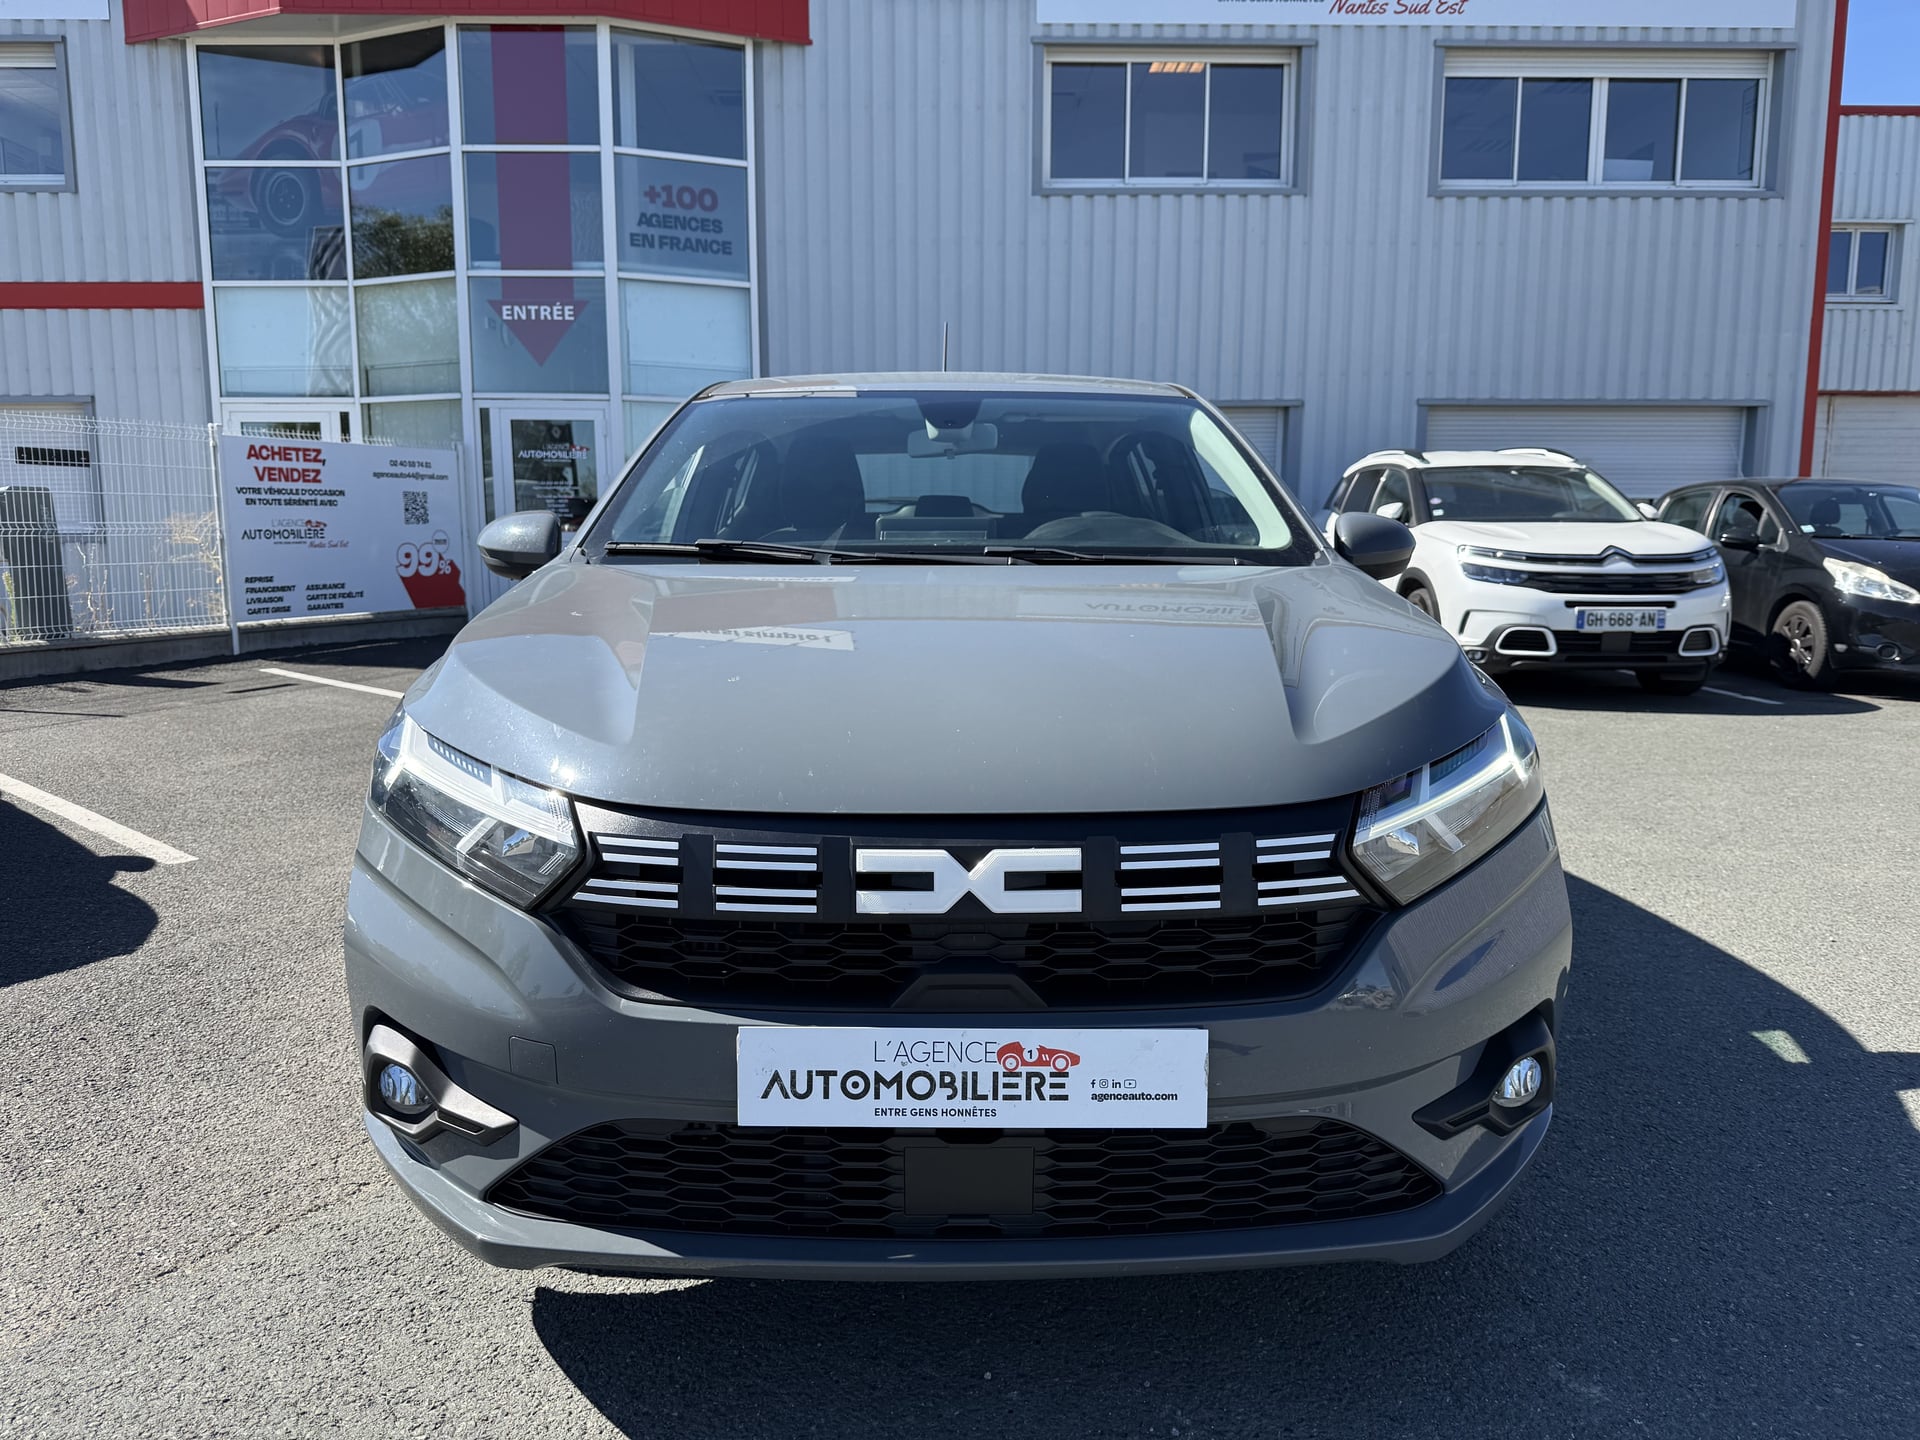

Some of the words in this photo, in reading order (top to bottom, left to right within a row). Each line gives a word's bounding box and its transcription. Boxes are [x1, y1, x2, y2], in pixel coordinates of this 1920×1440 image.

[1328, 0, 1387, 15] Nantes
[1393, 0, 1432, 15] Sud
[1435, 0, 1468, 15] Est
[644, 184, 718, 212] +100
[637, 212, 723, 234] AGENCES
[629, 232, 655, 249] EN
[658, 237, 733, 255] FRANCE
[502, 302, 575, 321] ENTRÉE
[253, 466, 322, 483] VENDEZ
[236, 487, 262, 495] VOTRE
[263, 486, 300, 496] VÉHICULE
[301, 488, 345, 497] D'OCCASION
[245, 498, 256, 506] EN
[258, 498, 281, 506] TOUTE
[319, 499, 338, 507] AVEC
[245, 576, 274, 584] REPRISE
[245, 585, 296, 594] FINANCEMENT
[305, 582, 345, 591] ASSURANCE
[246, 596, 284, 605] LIVRAISON
[306, 593, 327, 601] CARTE
[328, 592, 337, 600] DE
[247, 607, 269, 615] CARTE
[271, 605, 291, 613] GRISE
[307, 602, 344, 611] GARANTIES
[1586, 612, 1656, 627] GH-668-AN
[873, 1040, 998, 1064] L'AGENCE
[1027, 1049, 1033, 1060] 1
[1090, 1092, 1179, 1103] agenceauto.com
[874, 1107, 908, 1117] ENTRE
[910, 1107, 938, 1117] GENS
[941, 1105, 997, 1118] HONNÊTES
